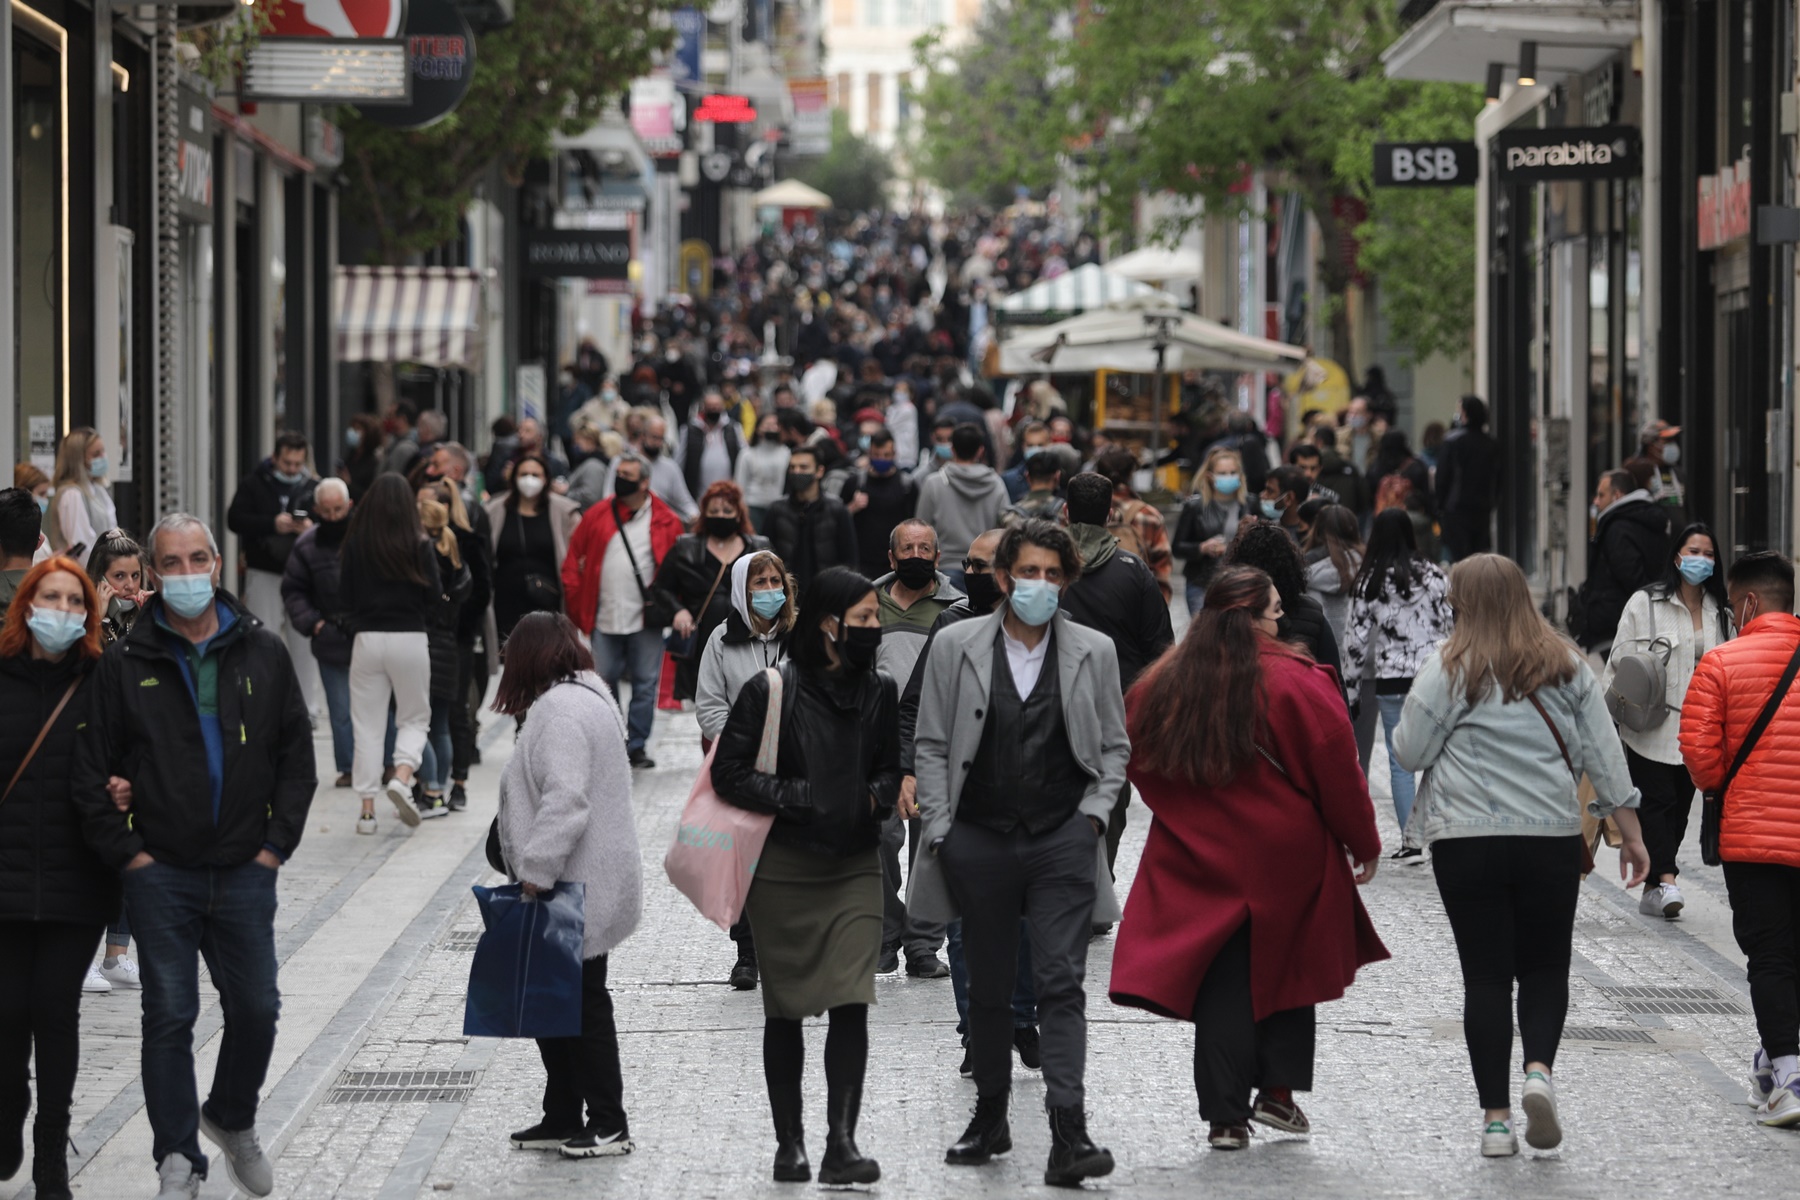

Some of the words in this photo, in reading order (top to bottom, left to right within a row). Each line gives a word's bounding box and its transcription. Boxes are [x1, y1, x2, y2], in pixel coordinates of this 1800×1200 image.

[1392, 147, 1458, 181] BSB
[1507, 139, 1611, 171] parabita
[529, 242, 629, 264] ROMANO
